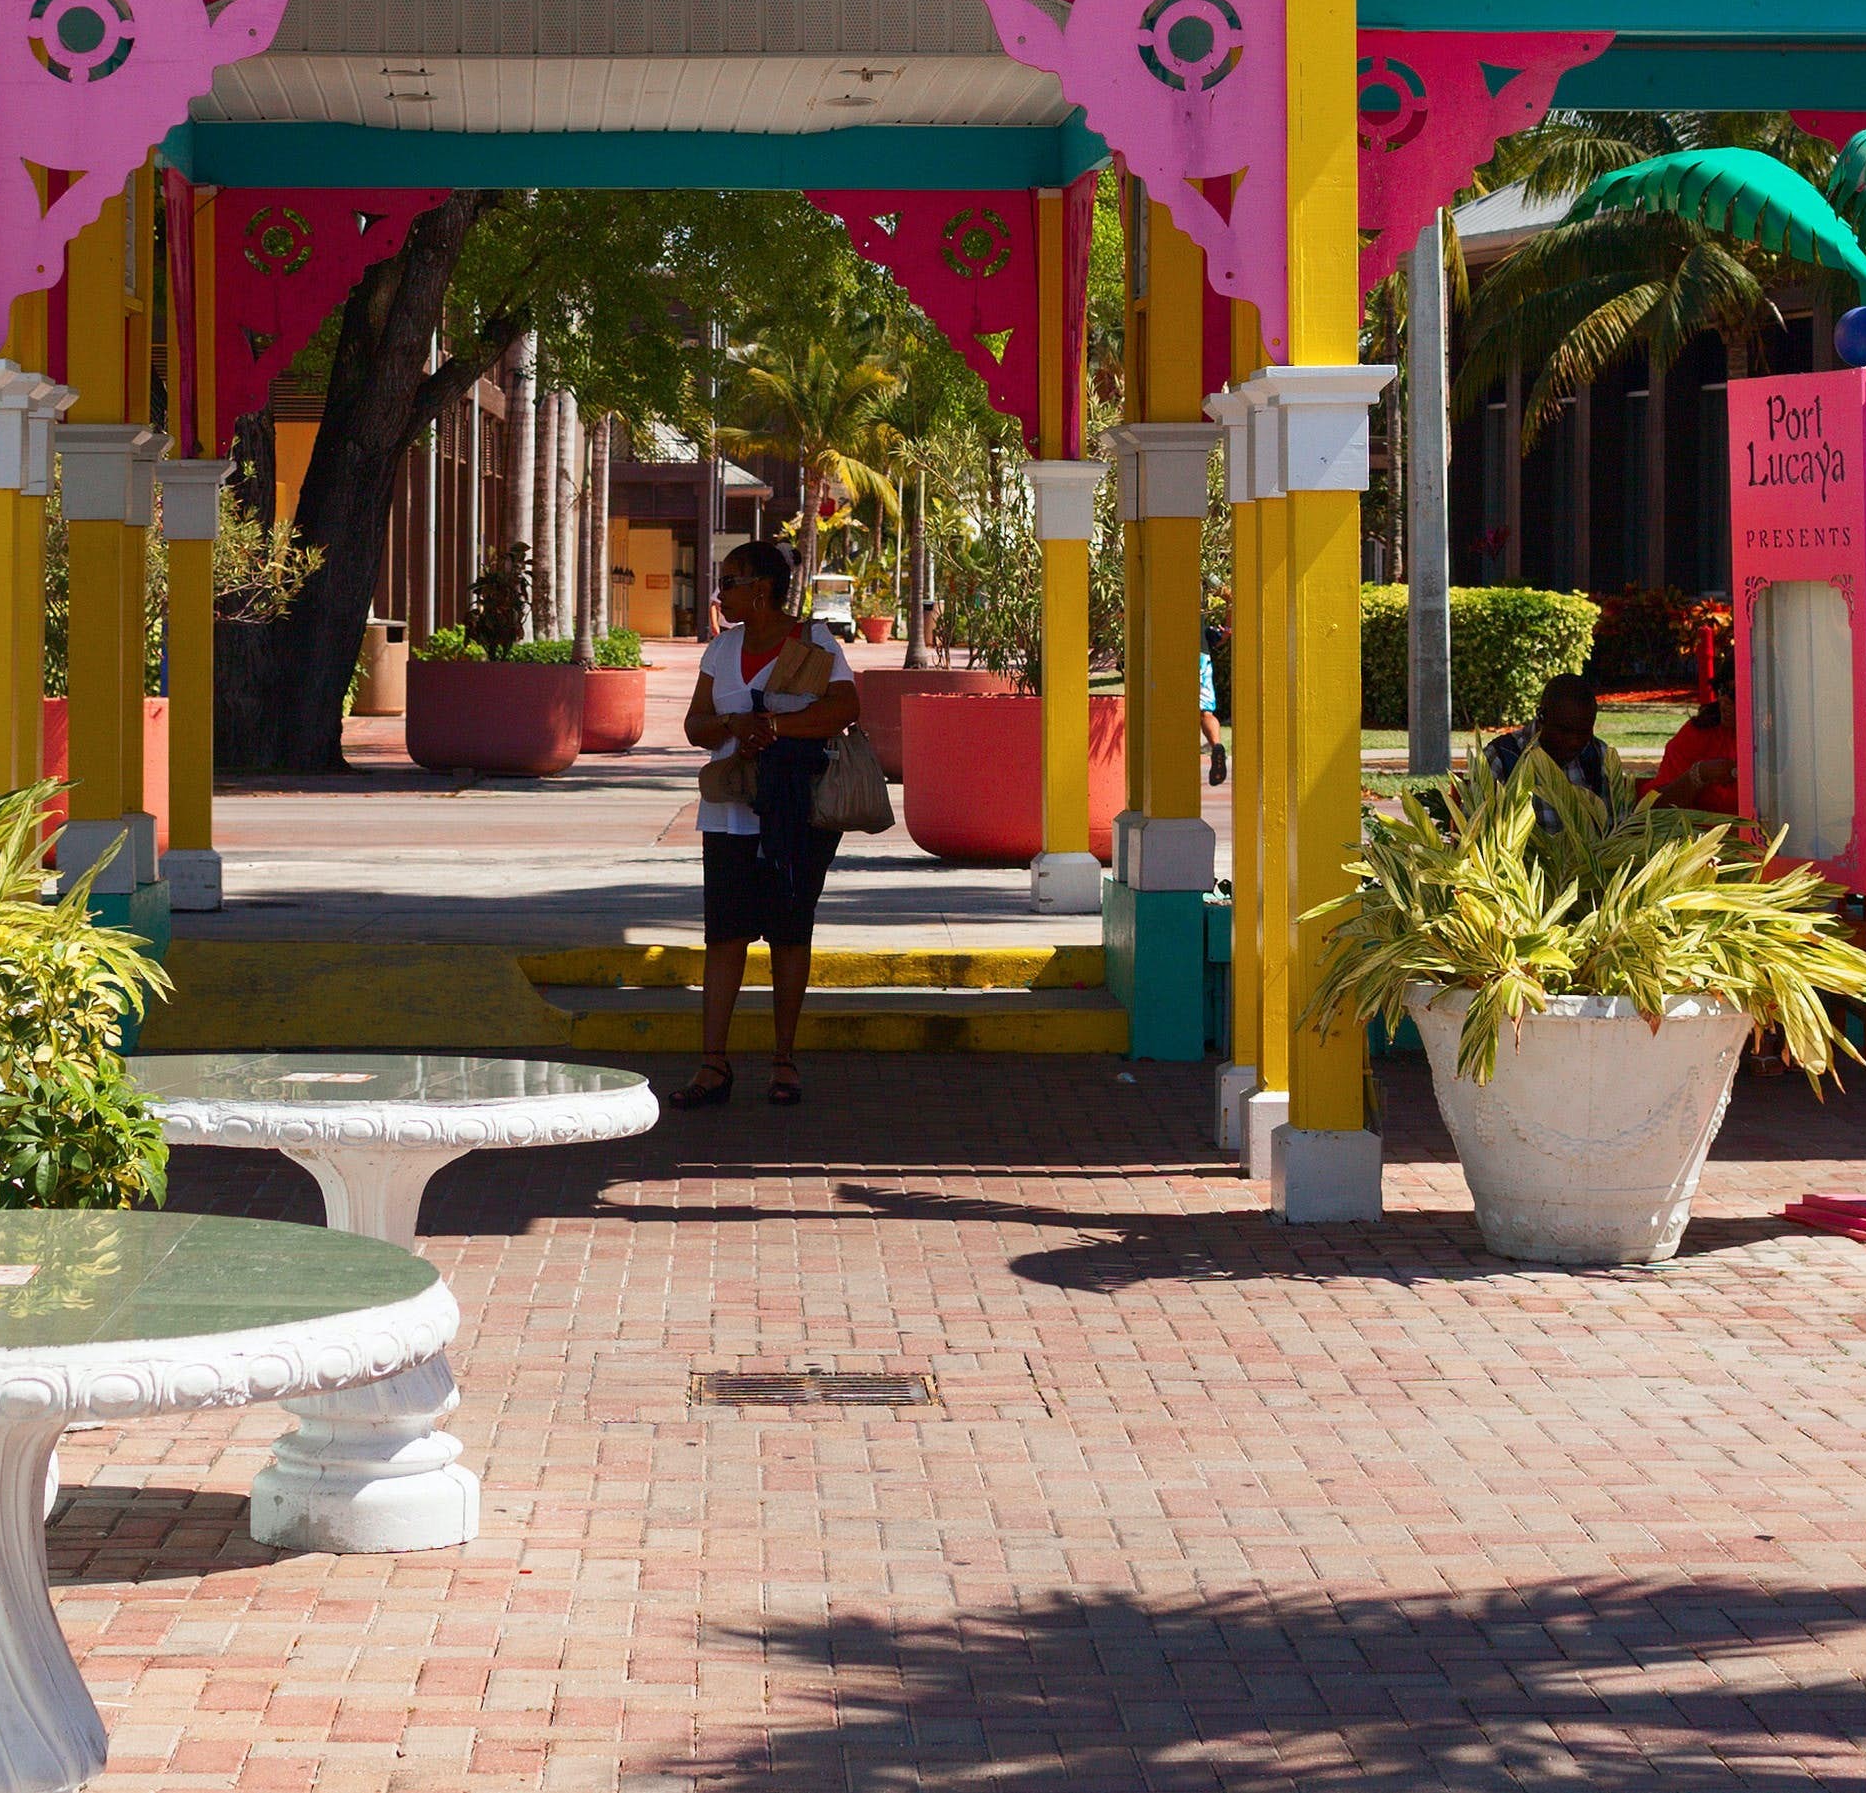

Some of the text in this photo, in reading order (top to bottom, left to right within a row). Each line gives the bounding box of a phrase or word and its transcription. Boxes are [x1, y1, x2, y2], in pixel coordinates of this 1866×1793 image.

[1767, 395, 1823, 441] Port
[1747, 441, 1845, 503] Lucaya
[1746, 527, 1852, 549] PRESENTS
